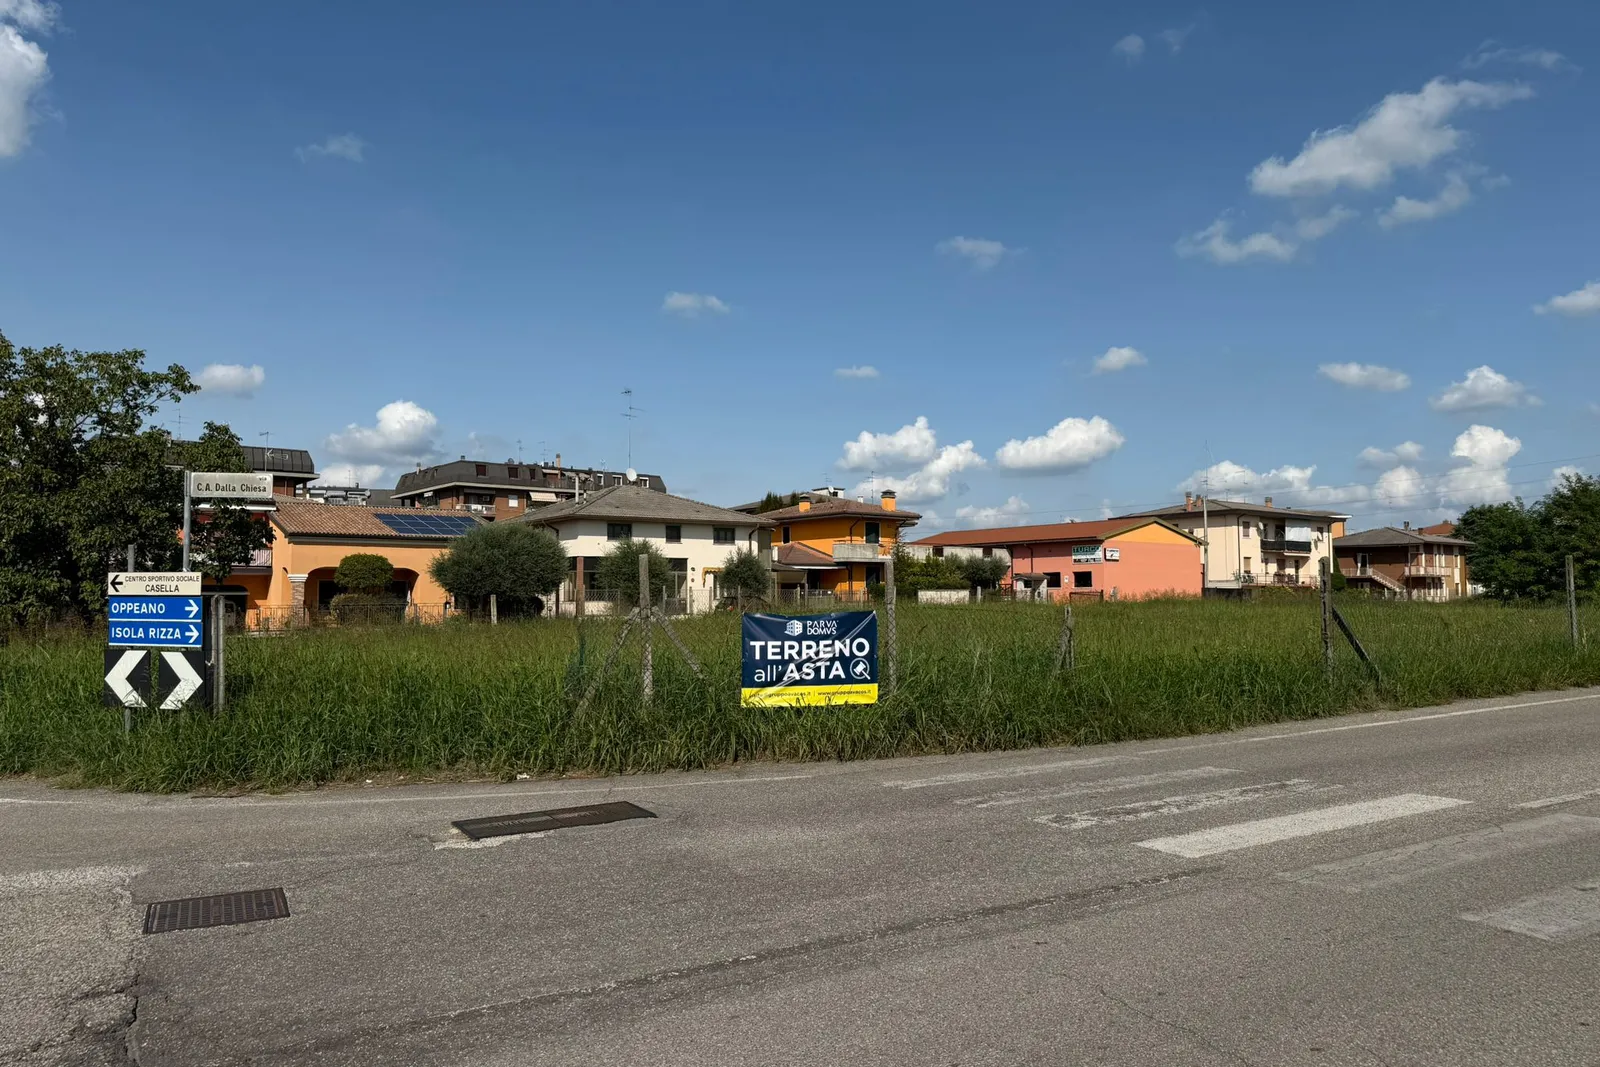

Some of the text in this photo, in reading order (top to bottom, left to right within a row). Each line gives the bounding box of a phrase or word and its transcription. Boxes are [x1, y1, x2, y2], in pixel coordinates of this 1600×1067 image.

[196, 482, 267, 492] C.A. Dalla Chiesa
[145, 584, 180, 593] CASELLA
[111, 603, 166, 614] OPPEANO
[806, 620, 837, 628] PARVA
[111, 627, 181, 639] ISOLA RIZZA
[750, 637, 870, 660] TERRENO
[753, 660, 846, 682] all'ASTA
